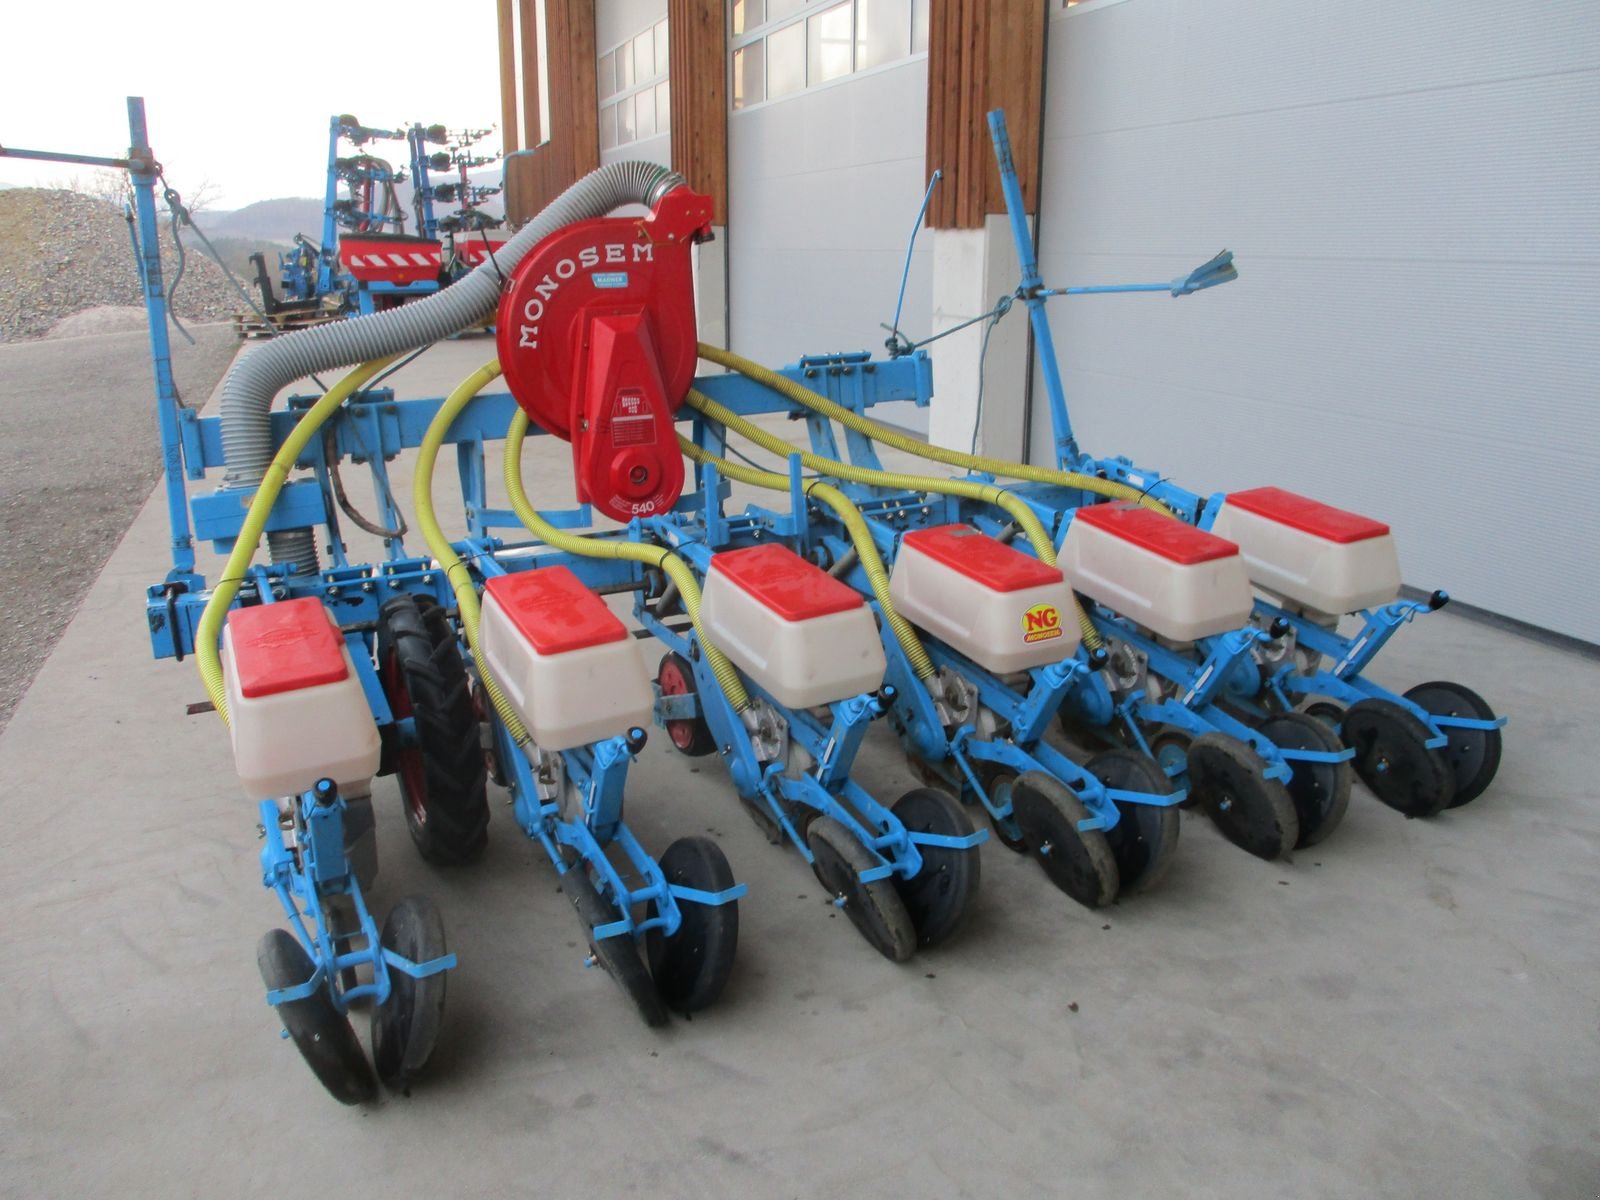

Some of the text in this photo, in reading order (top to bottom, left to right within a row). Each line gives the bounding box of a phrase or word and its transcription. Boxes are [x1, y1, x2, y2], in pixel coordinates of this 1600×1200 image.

[520, 243, 653, 349] MONOSEM
[631, 500, 655, 515] 540
[1025, 607, 1058, 632] NG
